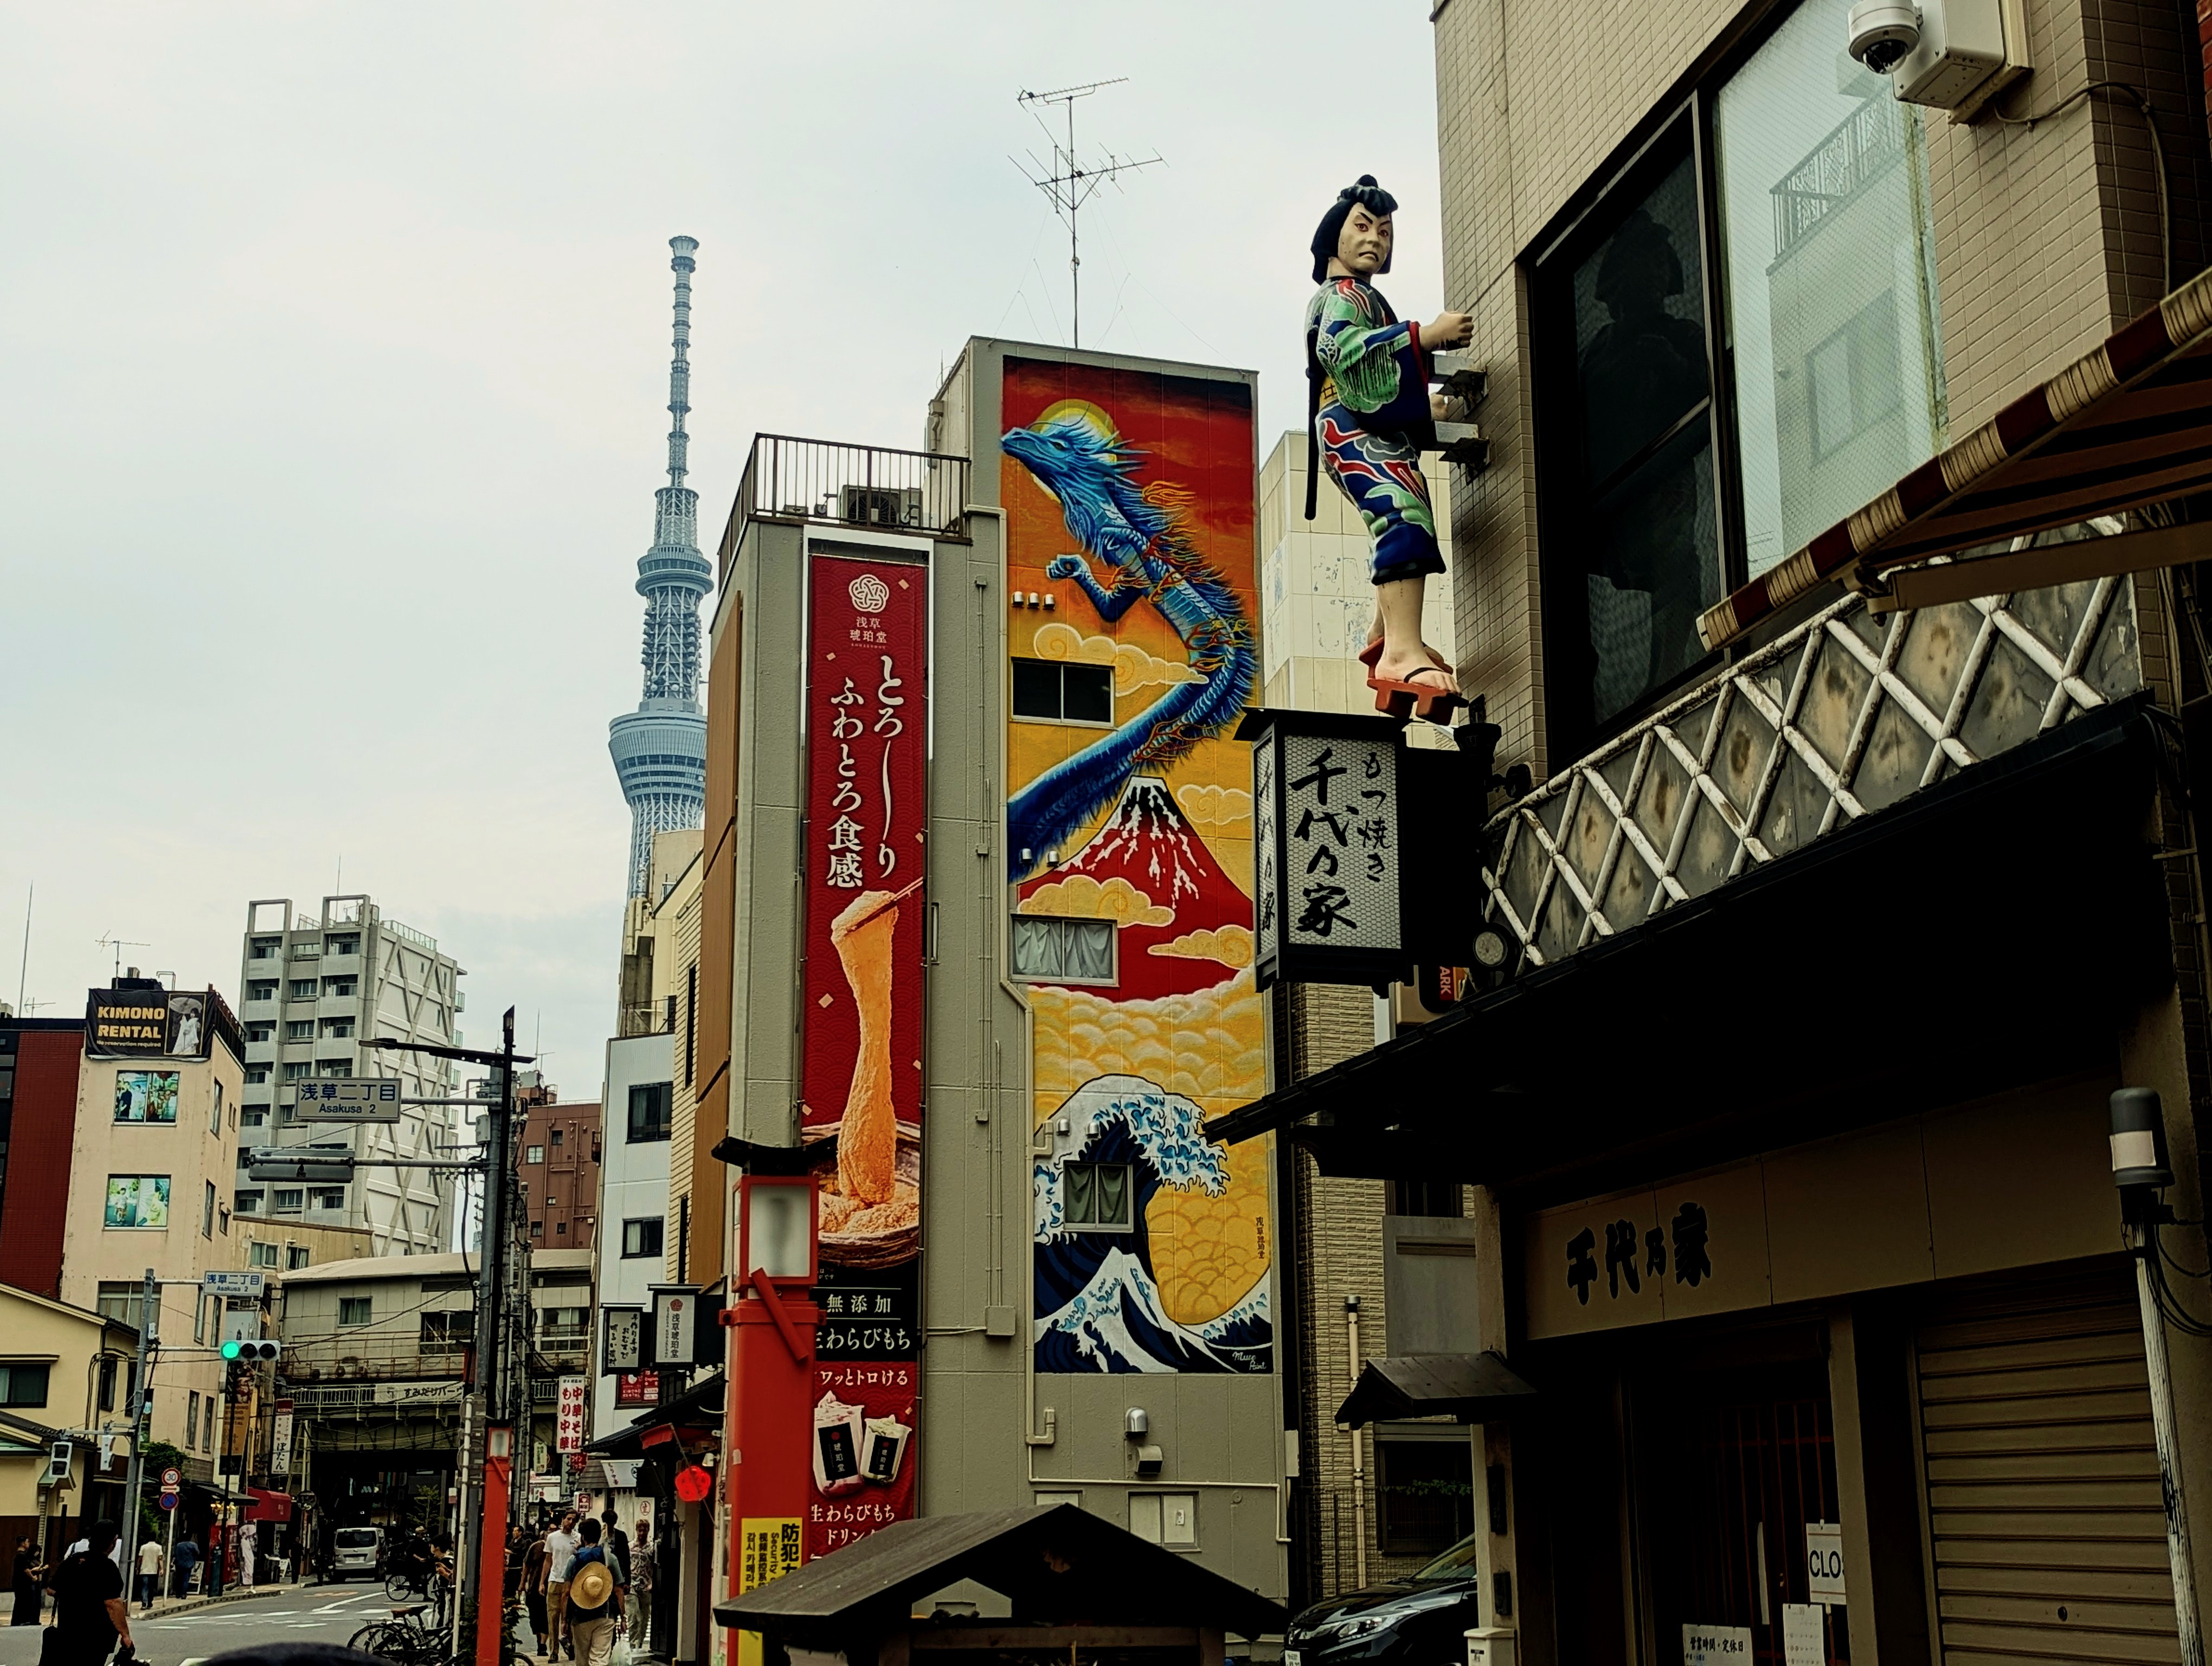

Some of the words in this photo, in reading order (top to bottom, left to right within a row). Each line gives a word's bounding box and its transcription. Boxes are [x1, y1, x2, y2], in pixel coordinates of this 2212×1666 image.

[857, 616, 880, 629] 浅草
[850, 630, 887, 644] 琥珀堂
[826, 676, 865, 888] ふわとろ食感
[1357, 752, 1392, 882] もつ焼き
[1288, 747, 1359, 938] 千代乃家
[1439, 966, 1452, 995] ARK
[98, 1006, 165, 1020] KIMONO
[98, 1024, 162, 1039] RENTAL
[300, 1083, 396, 1101] 浅草二丁目
[319, 1103, 362, 1113] Asakusa
[369, 1104, 376, 1114] 2
[207, 1274, 260, 1285] 浅草二丁目
[826, 1294, 891, 1313] 無添加
[671, 1313, 680, 1358] 浅草琥珀堂
[815, 1368, 908, 1386] ワッとトロける
[560, 1387, 571, 1450] もり中華
[571, 1386, 583, 1450] 中華そば
[833, 1443, 845, 1472] 琥珀堂
[878, 1449, 888, 1471] 琥珀堂
[811, 1504, 895, 1522] 生わらびもち
[746, 1532, 756, 1552] 감시
[769, 1532, 780, 1574] Security
[745, 1554, 755, 1583] 카메라
[1809, 1550, 1844, 1579] CLO
